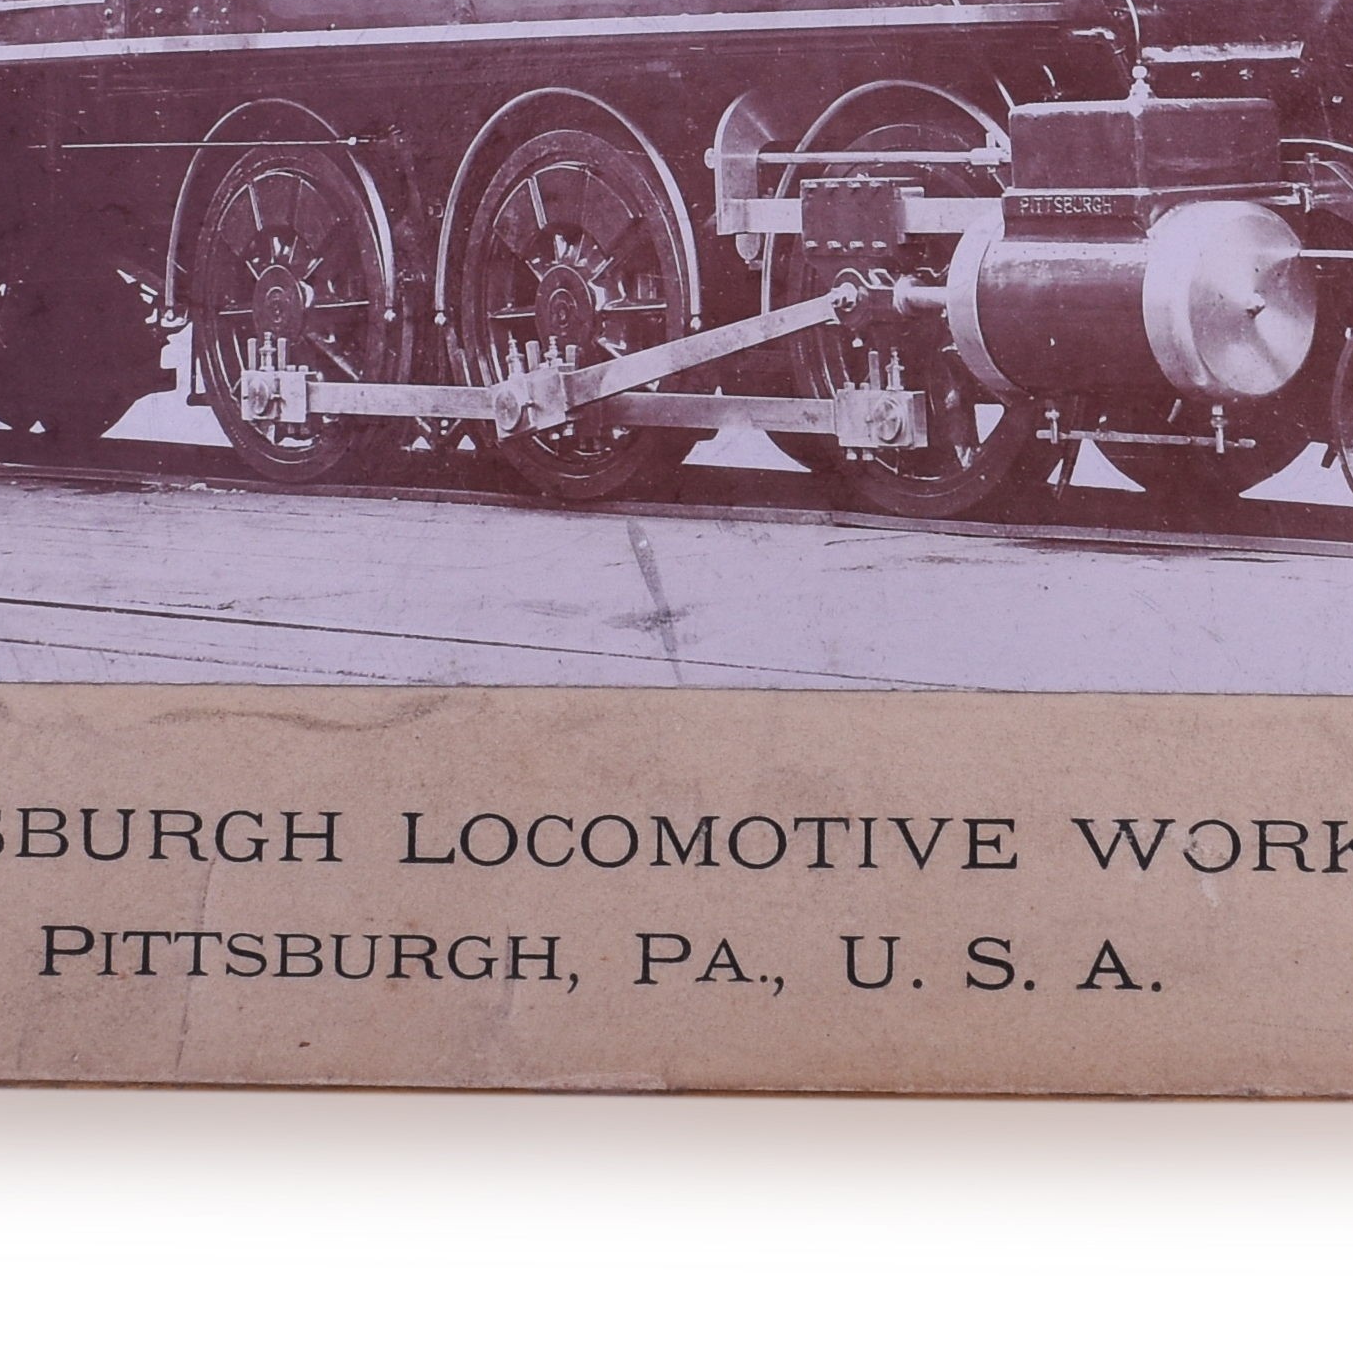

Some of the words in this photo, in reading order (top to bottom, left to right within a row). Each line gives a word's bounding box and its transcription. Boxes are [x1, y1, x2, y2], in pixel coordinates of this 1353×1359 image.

[1019, 195, 1114, 216] PITTSBURGH
[398, 812, 1019, 870] LOCOMOTIVE
[38, 925, 579, 994] PITTSBURGH,
[632, 932, 784, 997] PA.,
[839, 935, 923, 990] U.
[965, 936, 1035, 992] S.
[1075, 938, 1162, 993] A.
